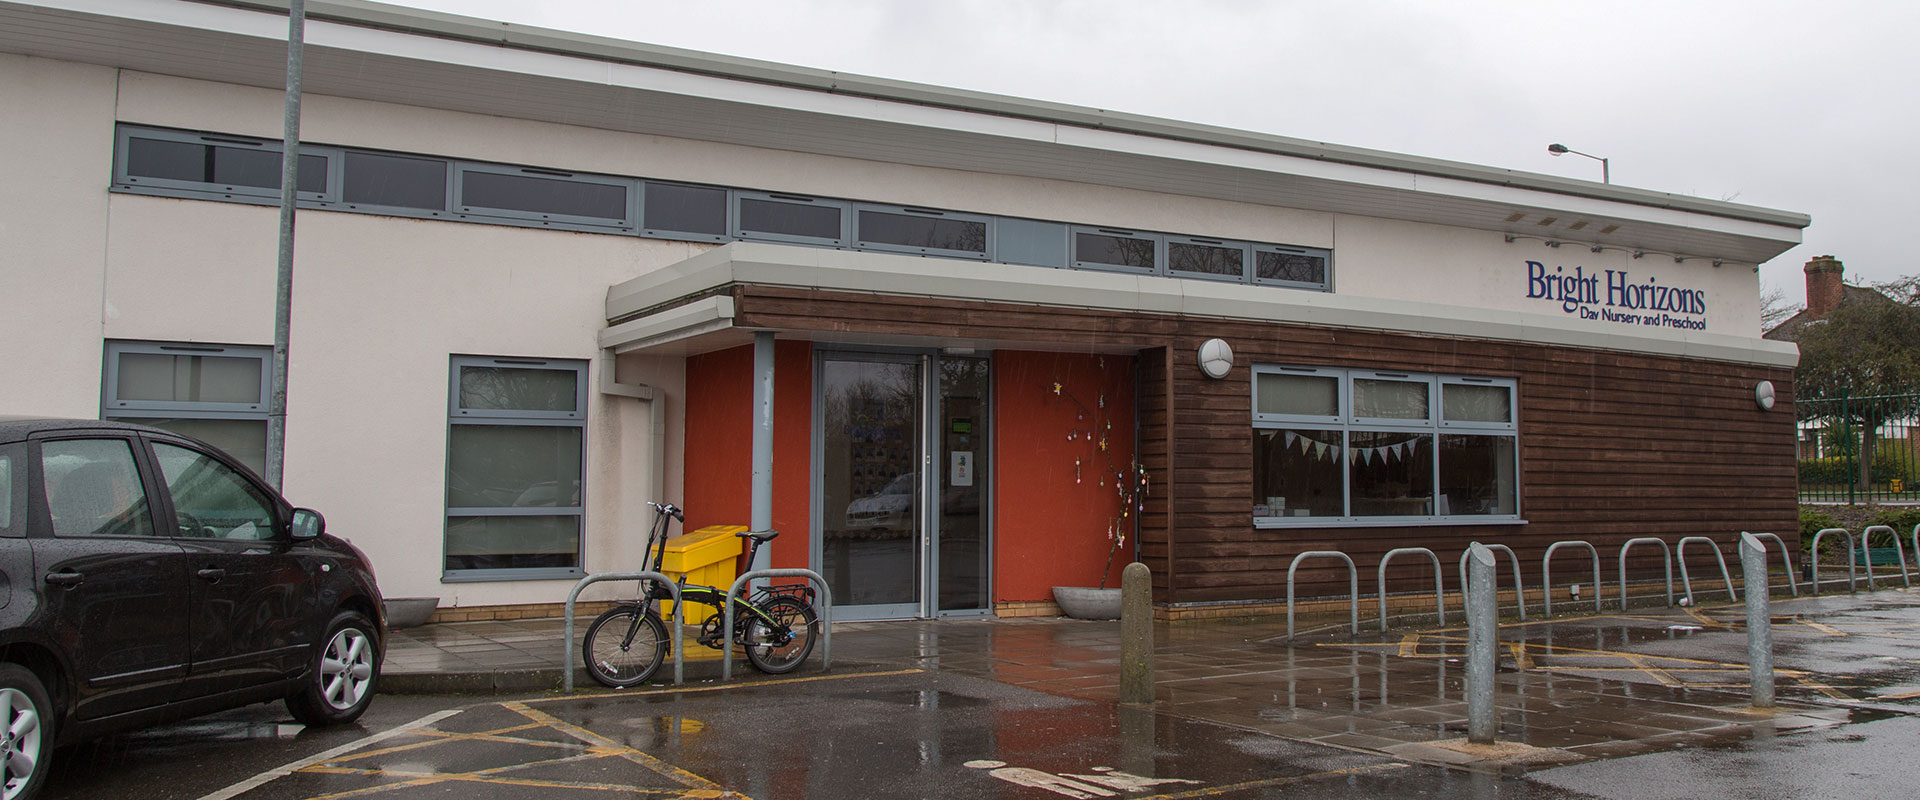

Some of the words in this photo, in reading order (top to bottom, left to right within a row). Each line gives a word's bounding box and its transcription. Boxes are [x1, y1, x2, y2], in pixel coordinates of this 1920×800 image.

[1525, 261, 1600, 313] Bright
[1605, 270, 1706, 315] Horizons
[1602, 308, 1641, 325] Nursery
[1644, 314, 1661, 326] and
[1663, 314, 1706, 330] Preschool
